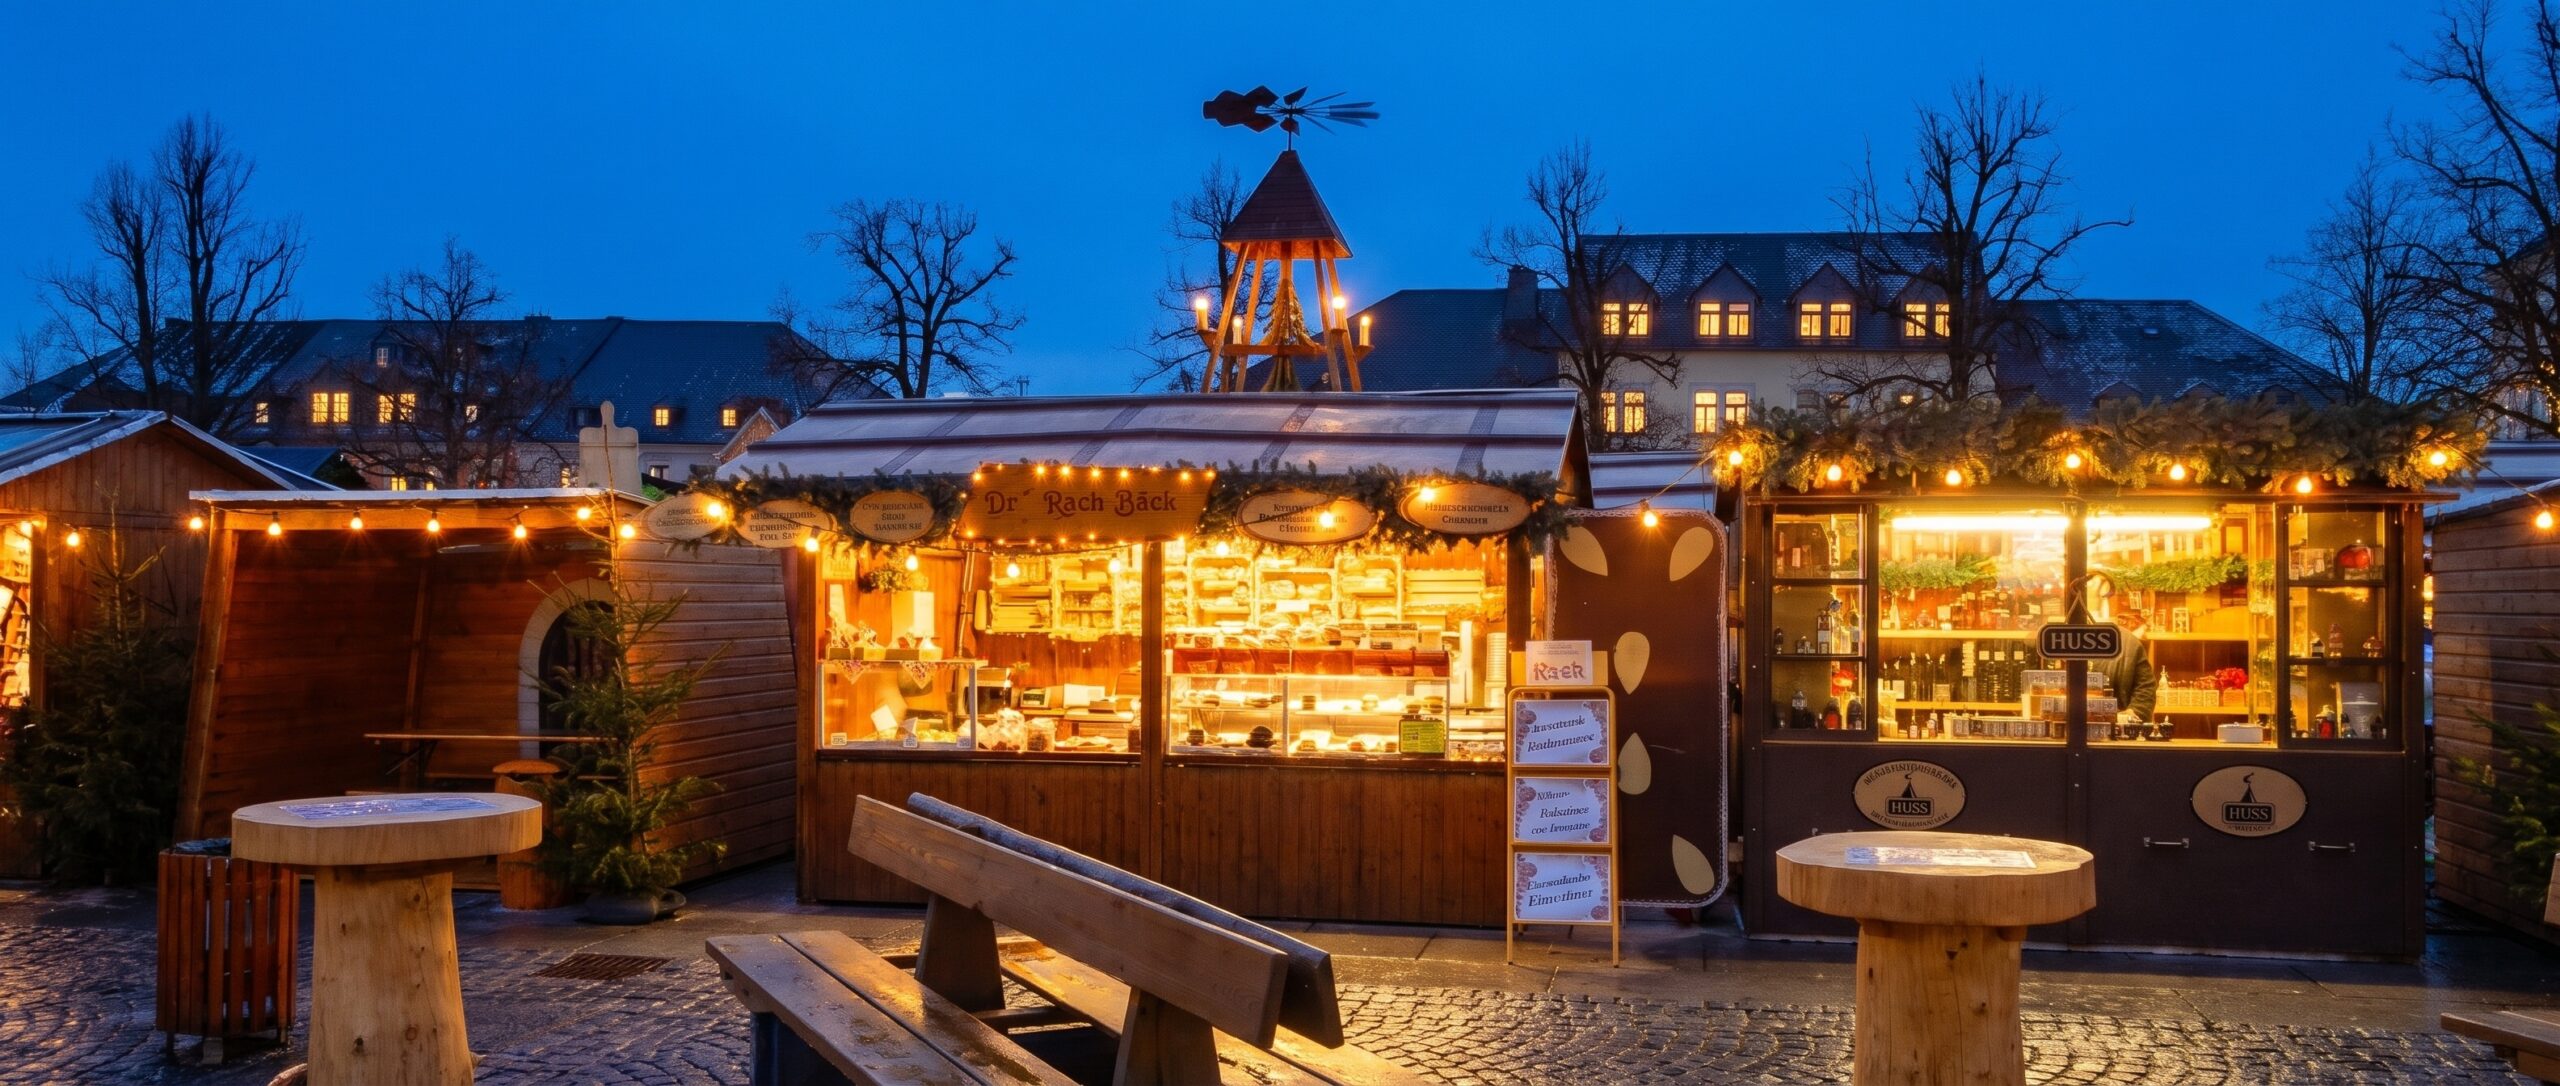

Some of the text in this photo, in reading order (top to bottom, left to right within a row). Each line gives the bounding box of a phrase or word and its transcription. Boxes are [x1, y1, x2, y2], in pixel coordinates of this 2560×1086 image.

[1043, 490, 1105, 520] Rach
[2051, 632, 2112, 650] HUSS
[1891, 801, 1929, 814] HUSS
[2229, 806, 2270, 820] HUSS
